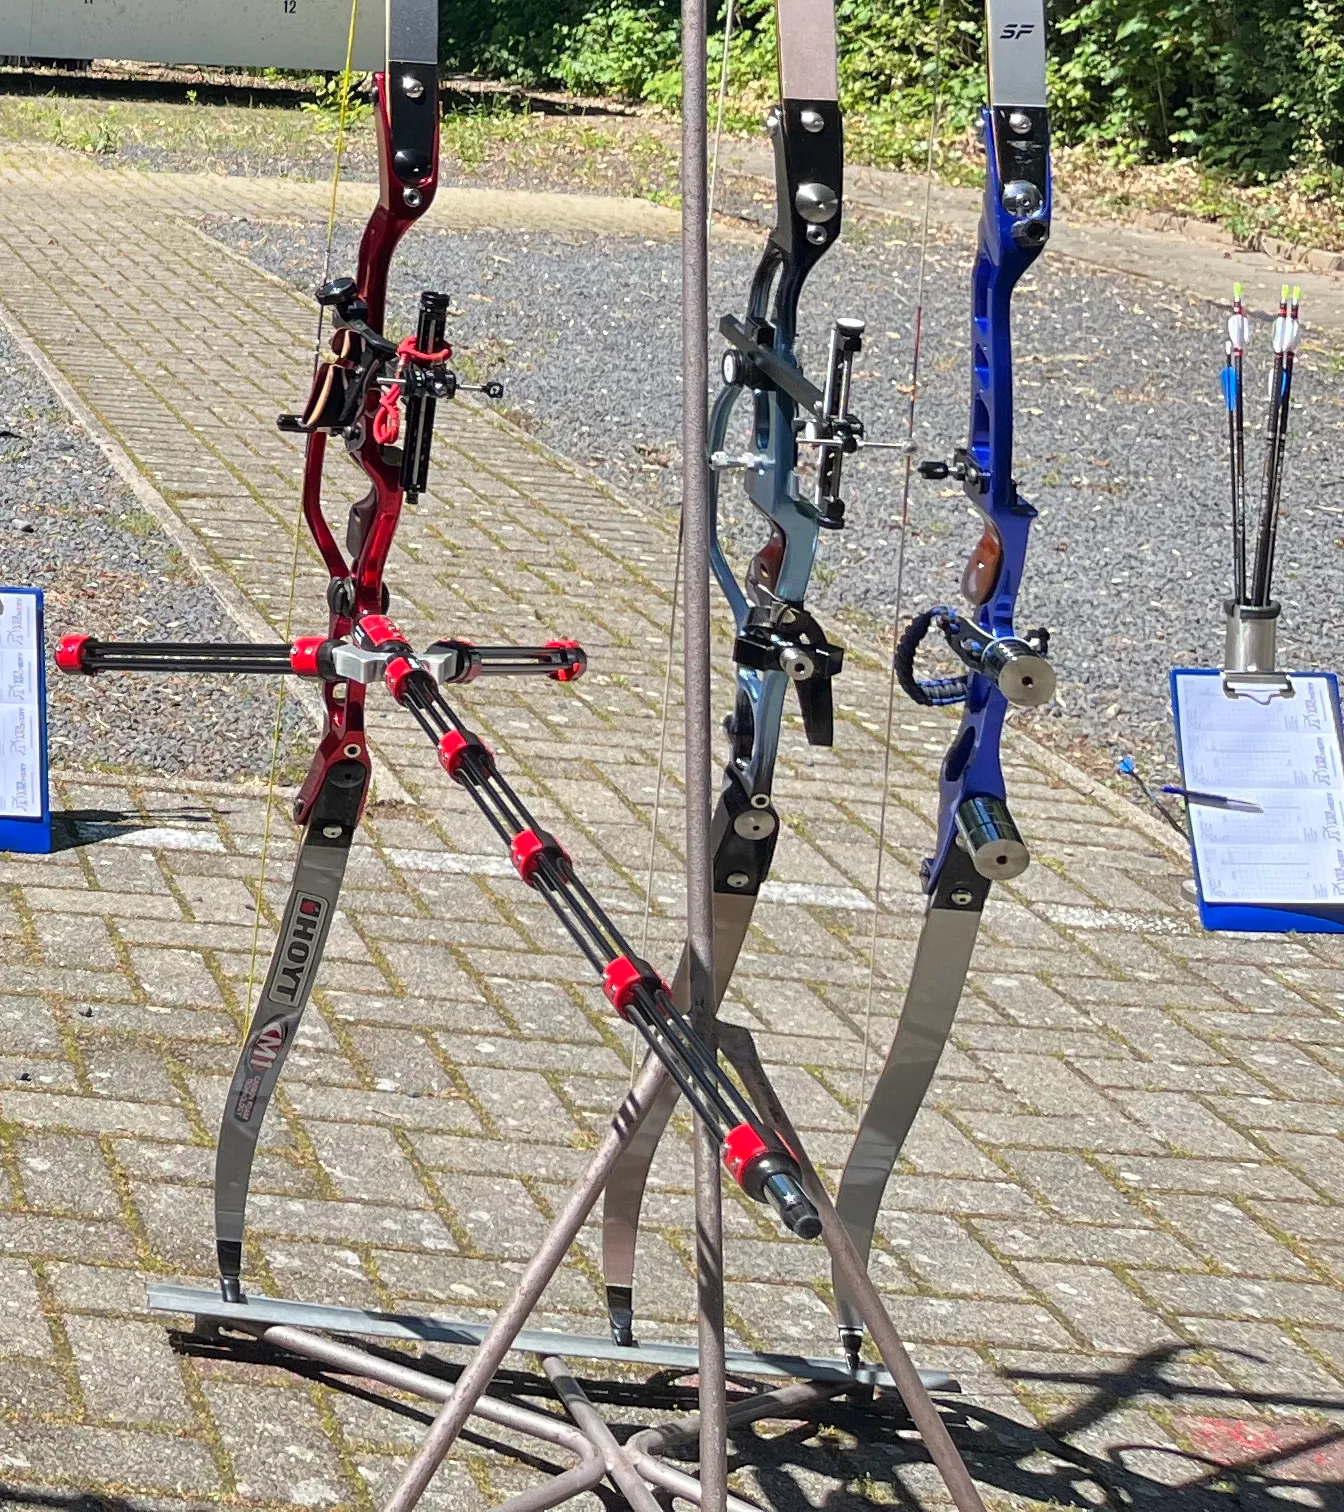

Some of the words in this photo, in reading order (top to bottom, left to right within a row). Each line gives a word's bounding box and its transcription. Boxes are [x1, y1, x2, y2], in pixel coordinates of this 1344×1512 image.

[283, 0, 297, 14] 12
[1000, 24, 1035, 39] SF
[276, 916, 317, 1003] HOYT
